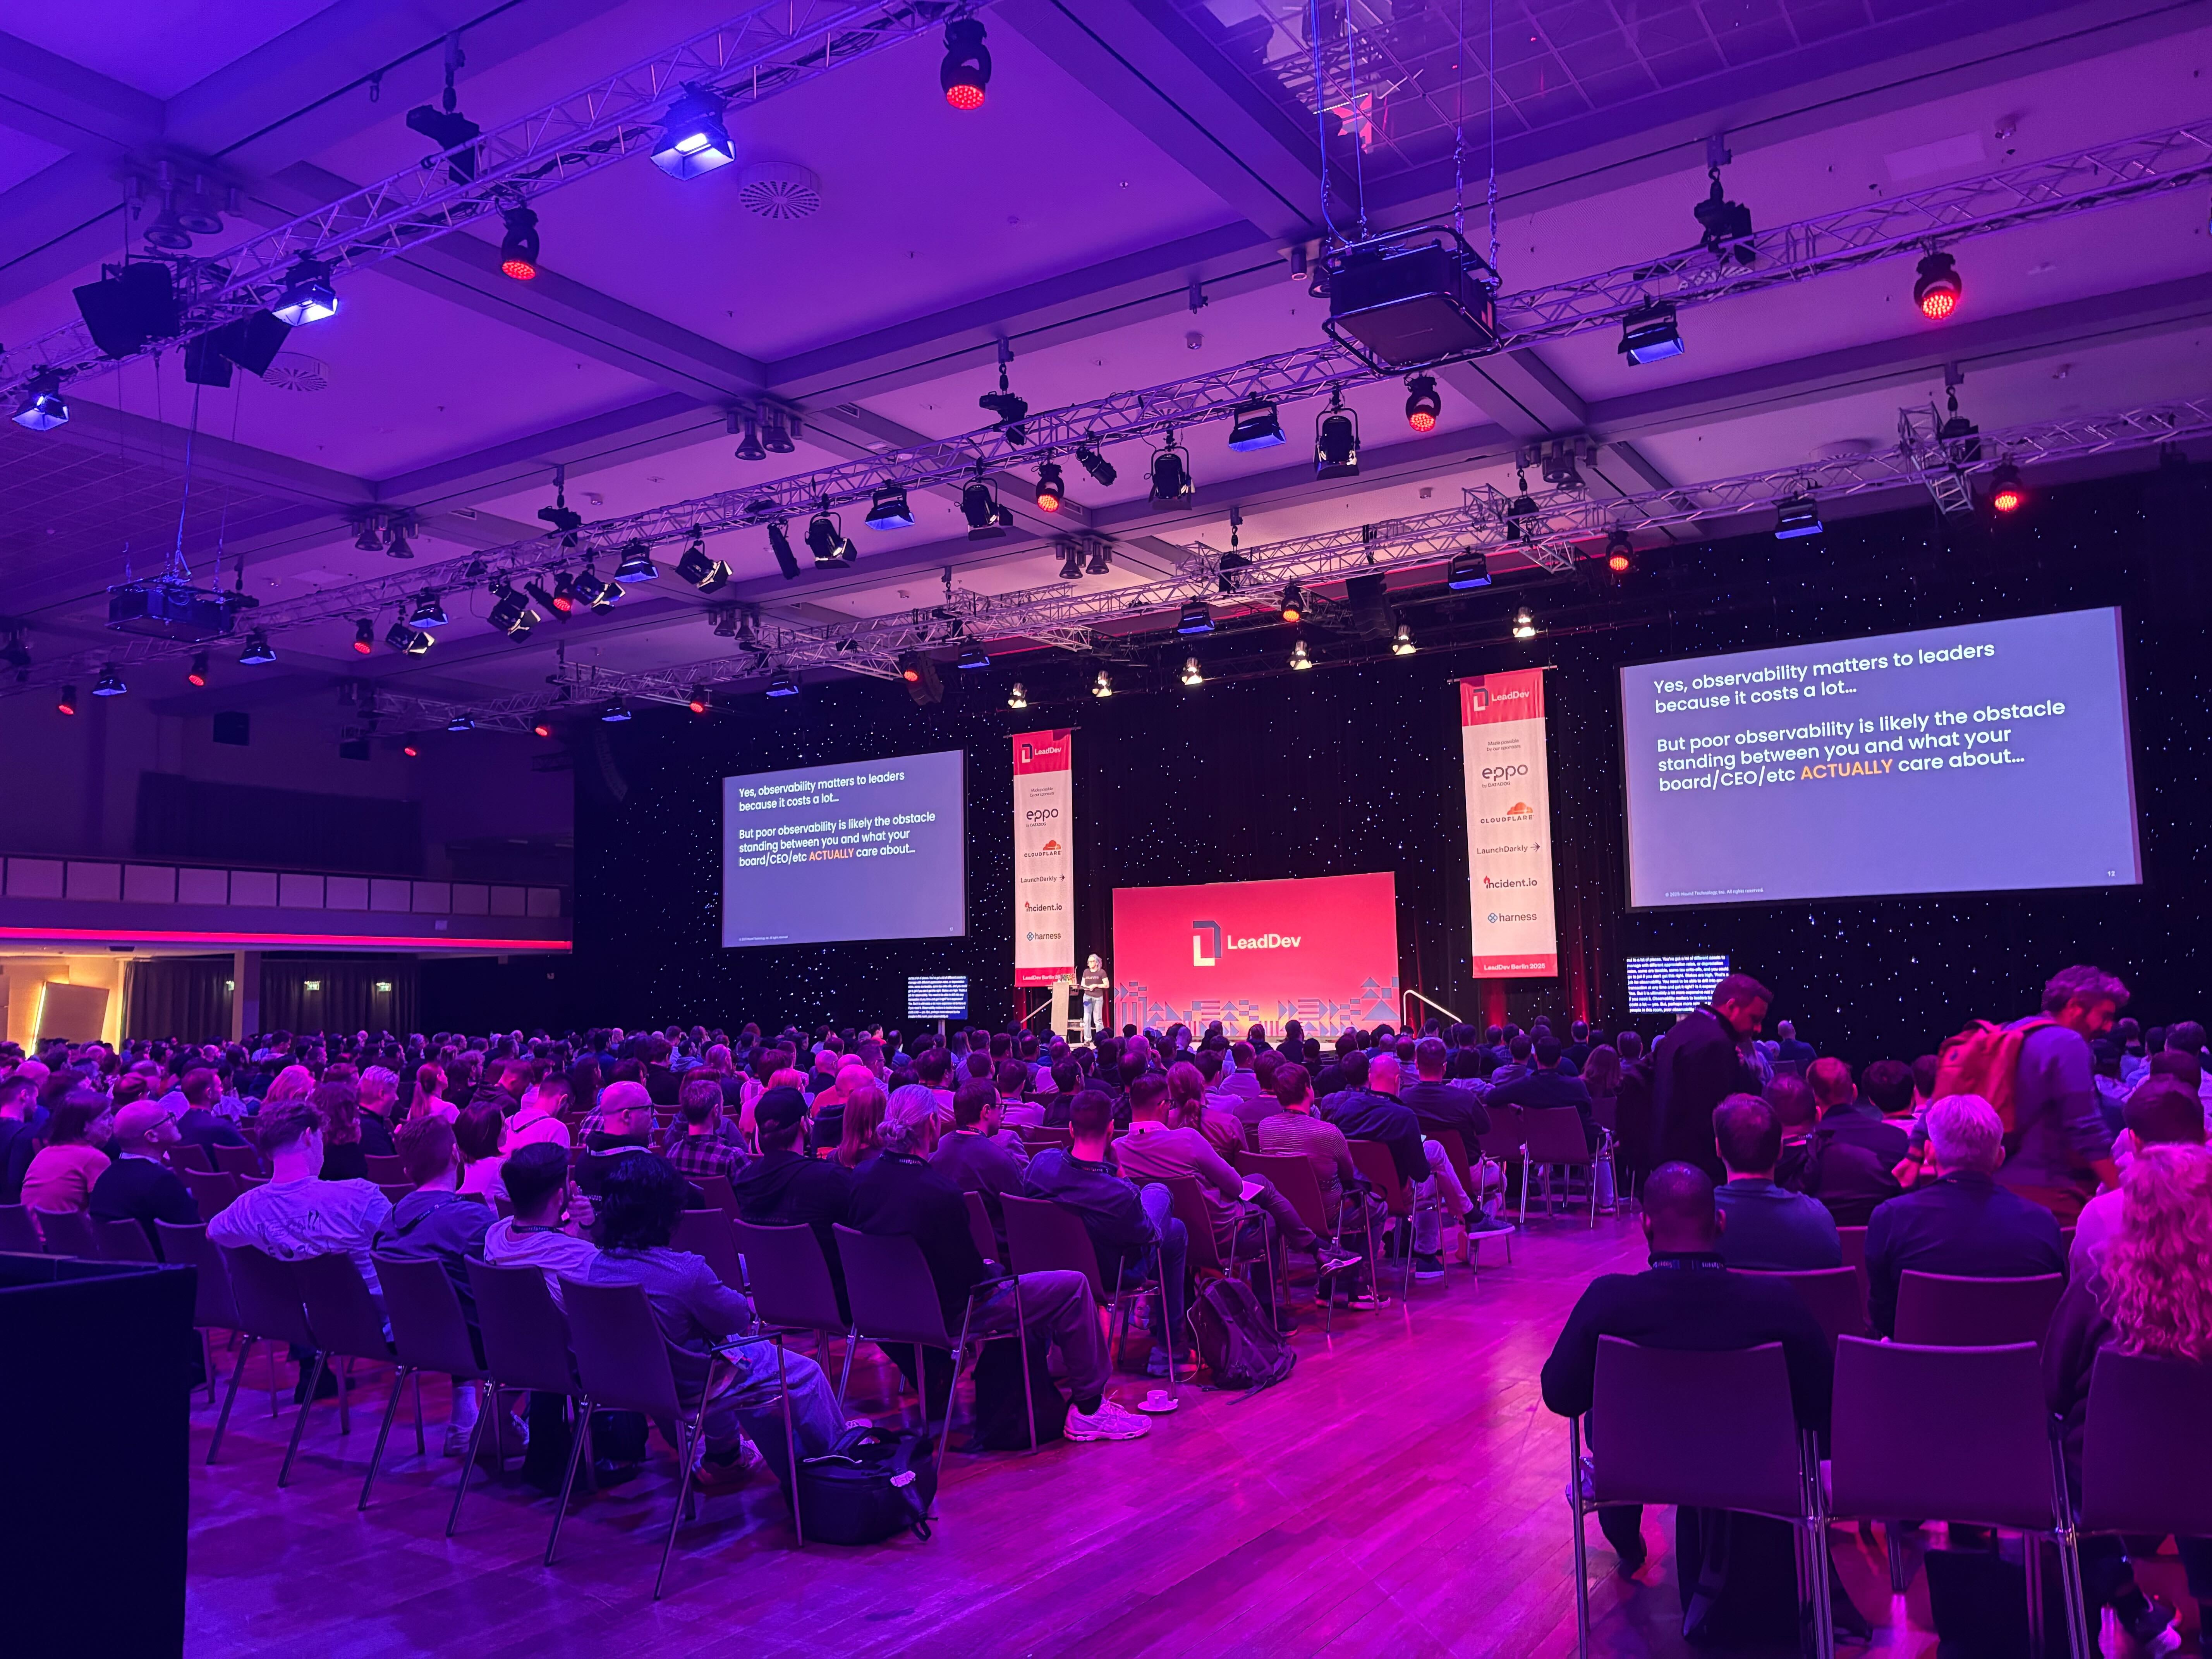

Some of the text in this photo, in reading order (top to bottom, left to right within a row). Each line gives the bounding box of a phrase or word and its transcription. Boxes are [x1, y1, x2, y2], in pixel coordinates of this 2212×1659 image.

[1654, 644, 1995, 694] Yes, observability matters to leaders
[1491, 690, 1530, 702] LeadDev
[1656, 695, 1730, 713] because
[1735, 690, 1747, 705] it
[1750, 686, 1799, 703] costs
[1803, 685, 1815, 697] a
[1657, 700, 2065, 754] But poor observability is likely the obstacle
[1034, 747, 1062, 755] LeadDev
[1658, 729, 2011, 772] standing between you and what your
[1482, 764, 1528, 781] eppo
[1659, 765, 1795, 791] board/CEO/etc
[1801, 759, 1893, 780] ACTUALLY
[1898, 757, 1944, 772] care
[739, 771, 905, 798] Yes, observability matters to leaders
[739, 800, 777, 812] because
[779, 797, 785, 807] it
[787, 796, 811, 807] costs
[812, 796, 819, 804] a
[1026, 809, 1058, 822] eppo
[1480, 815, 1533, 824] CLOUDFLARE
[739, 811, 936, 841] But poor observability is likely the obstacle
[739, 830, 910, 853] standing between you and what your
[1477, 844, 1528, 854] LaunchDarkly
[739, 850, 807, 867] board/CEO/etc
[809, 848, 854, 861] ACTUALLY
[856, 848, 878, 857] care
[1020, 875, 1057, 883] LaunchDarkly
[1485, 877, 1537, 889] incident.io
[1026, 902, 1063, 912] incident.io
[1499, 912, 1537, 923] harness
[1035, 932, 1061, 940] harness
[1227, 933, 1301, 950] LeadDev
